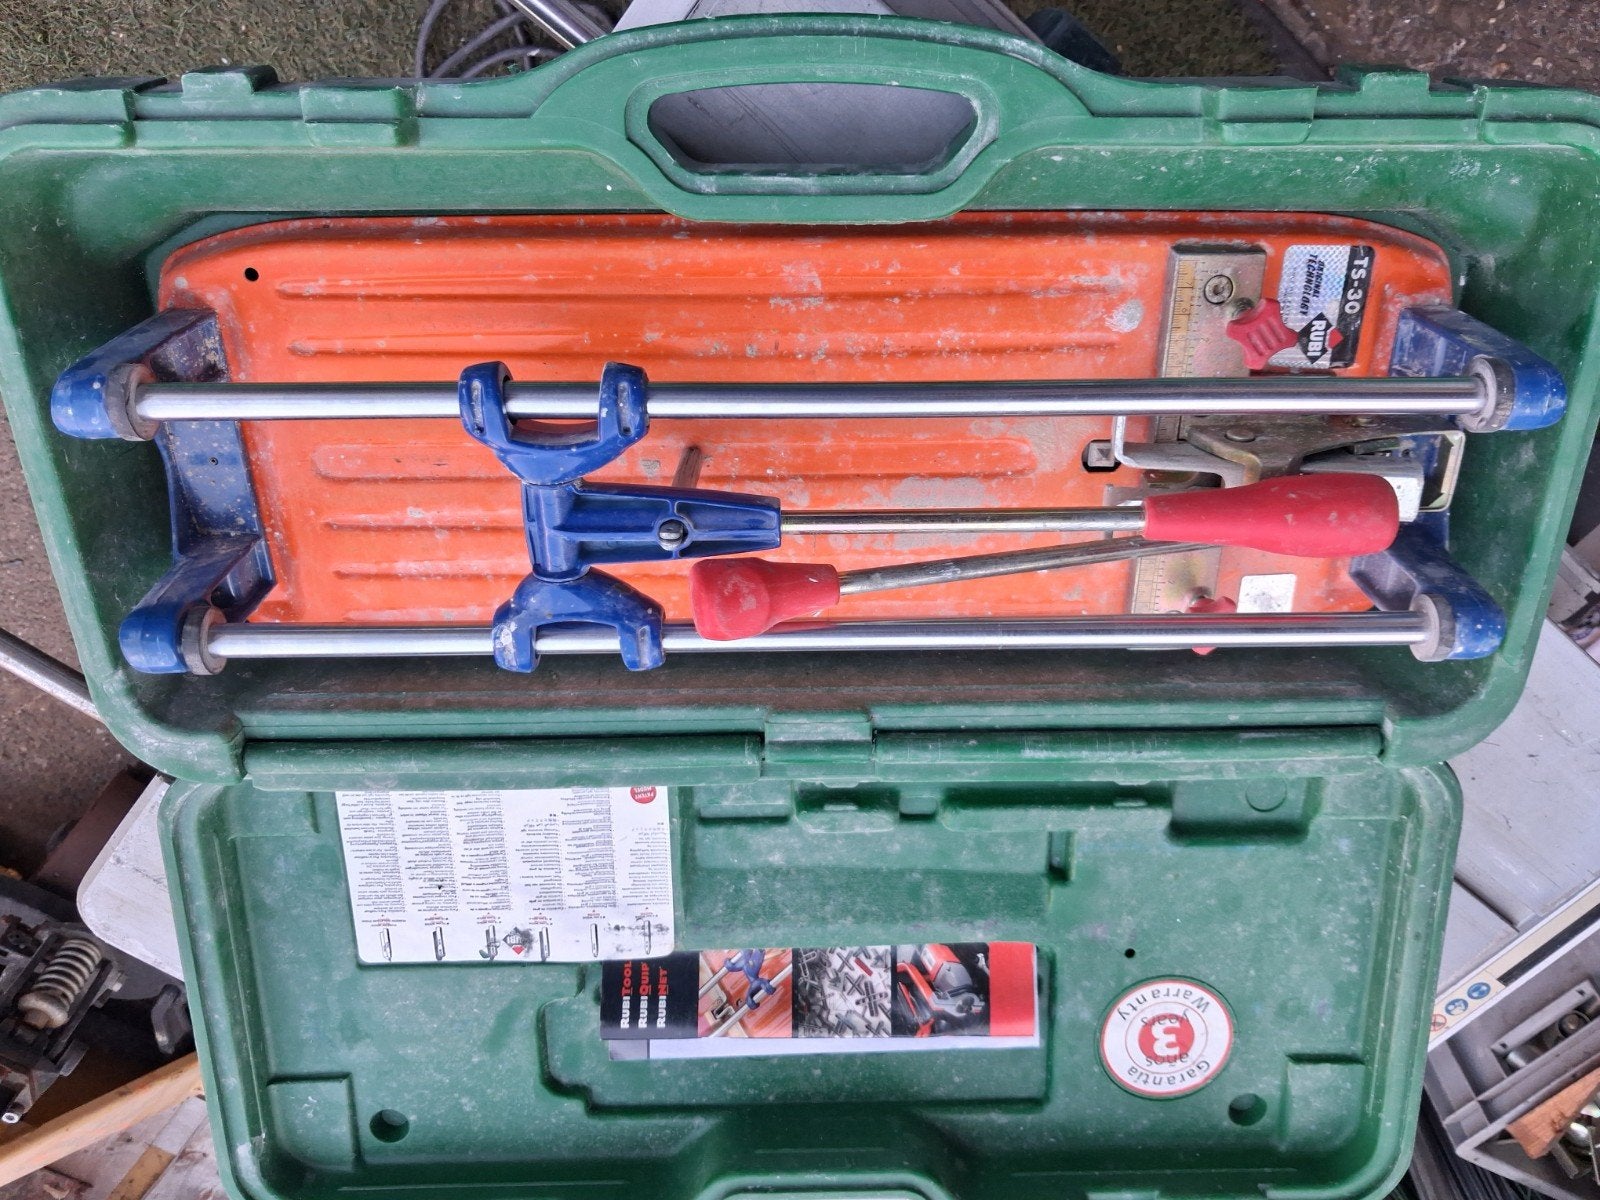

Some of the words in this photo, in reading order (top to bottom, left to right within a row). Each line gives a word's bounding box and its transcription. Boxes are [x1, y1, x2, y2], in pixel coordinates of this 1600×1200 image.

[1300, 254, 1318, 315] TECHNOLOGY
[1311, 260, 1325, 298] ORIGINAL
[1344, 256, 1370, 315] TS-30
[1306, 320, 1328, 357] RUBI
[638, 962, 651, 1029] RUBIQUIP
[656, 967, 668, 1029] RUBINET
[1117, 987, 1210, 1021] Warranty
[1151, 1021, 1180, 1056] 3
